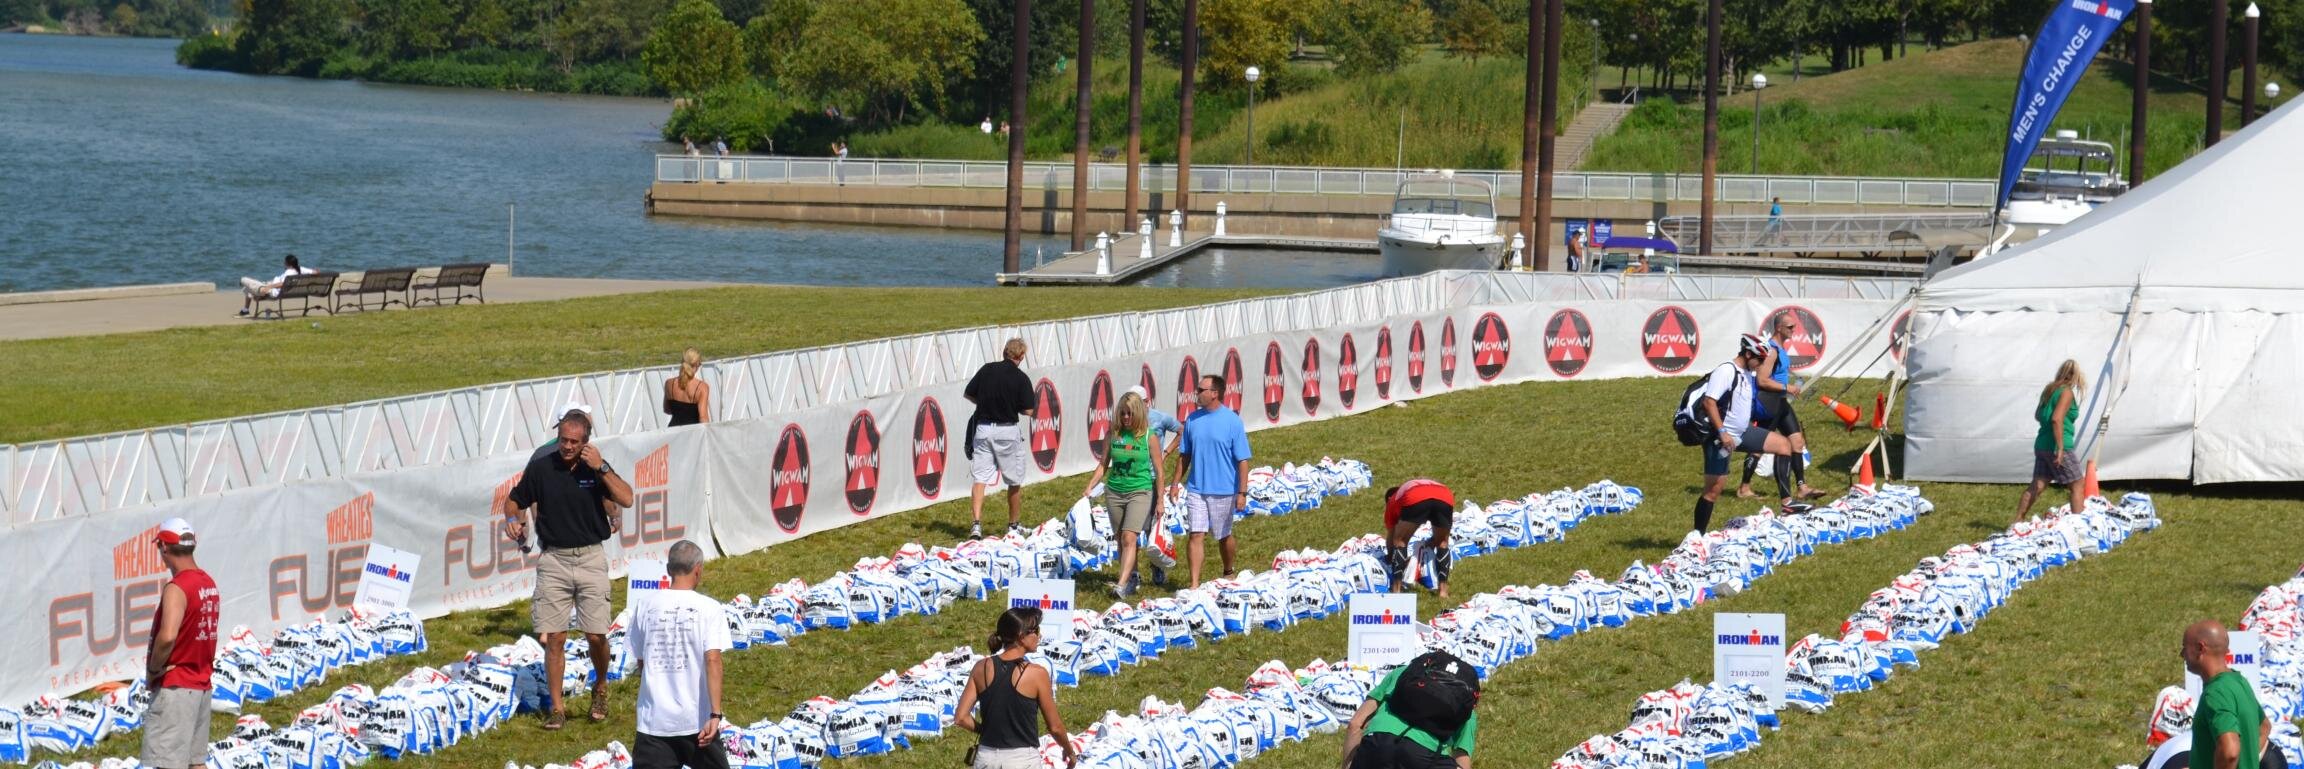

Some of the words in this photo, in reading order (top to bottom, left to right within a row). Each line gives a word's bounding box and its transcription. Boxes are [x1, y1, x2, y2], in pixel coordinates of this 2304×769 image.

[2012, 92, 2046, 144] MEN'S
[2043, 24, 2092, 92] CHANGE
[1472, 339, 1509, 352] WIGWAM
[1546, 335, 1592, 348] WIGWAM
[1644, 331, 1697, 345] WIGWAM
[1763, 330, 1823, 347] WWAM
[1029, 414, 1060, 434] WIGWAM
[913, 434, 945, 457] WIGWAM
[635, 443, 669, 488] WHEATIES
[846, 450, 879, 474] WIGWAM
[772, 463, 809, 489] WIGWAM
[326, 490, 375, 545] WHEATIES
[619, 490, 686, 548] UEL
[269, 545, 371, 621] FUE
[366, 563, 411, 583] IRONMAN
[631, 575, 670, 590] IRONM
[1011, 594, 1068, 611] IRONMAN
[49, 579, 167, 667] FUE
[1353, 609, 1410, 625] IRONMAN
[1718, 629, 1779, 646] IRONMAN
[1363, 646, 1400, 654] 2301-2400
[51, 662, 120, 690] PREPARE
[1730, 669, 1770, 677] 2101-2200
